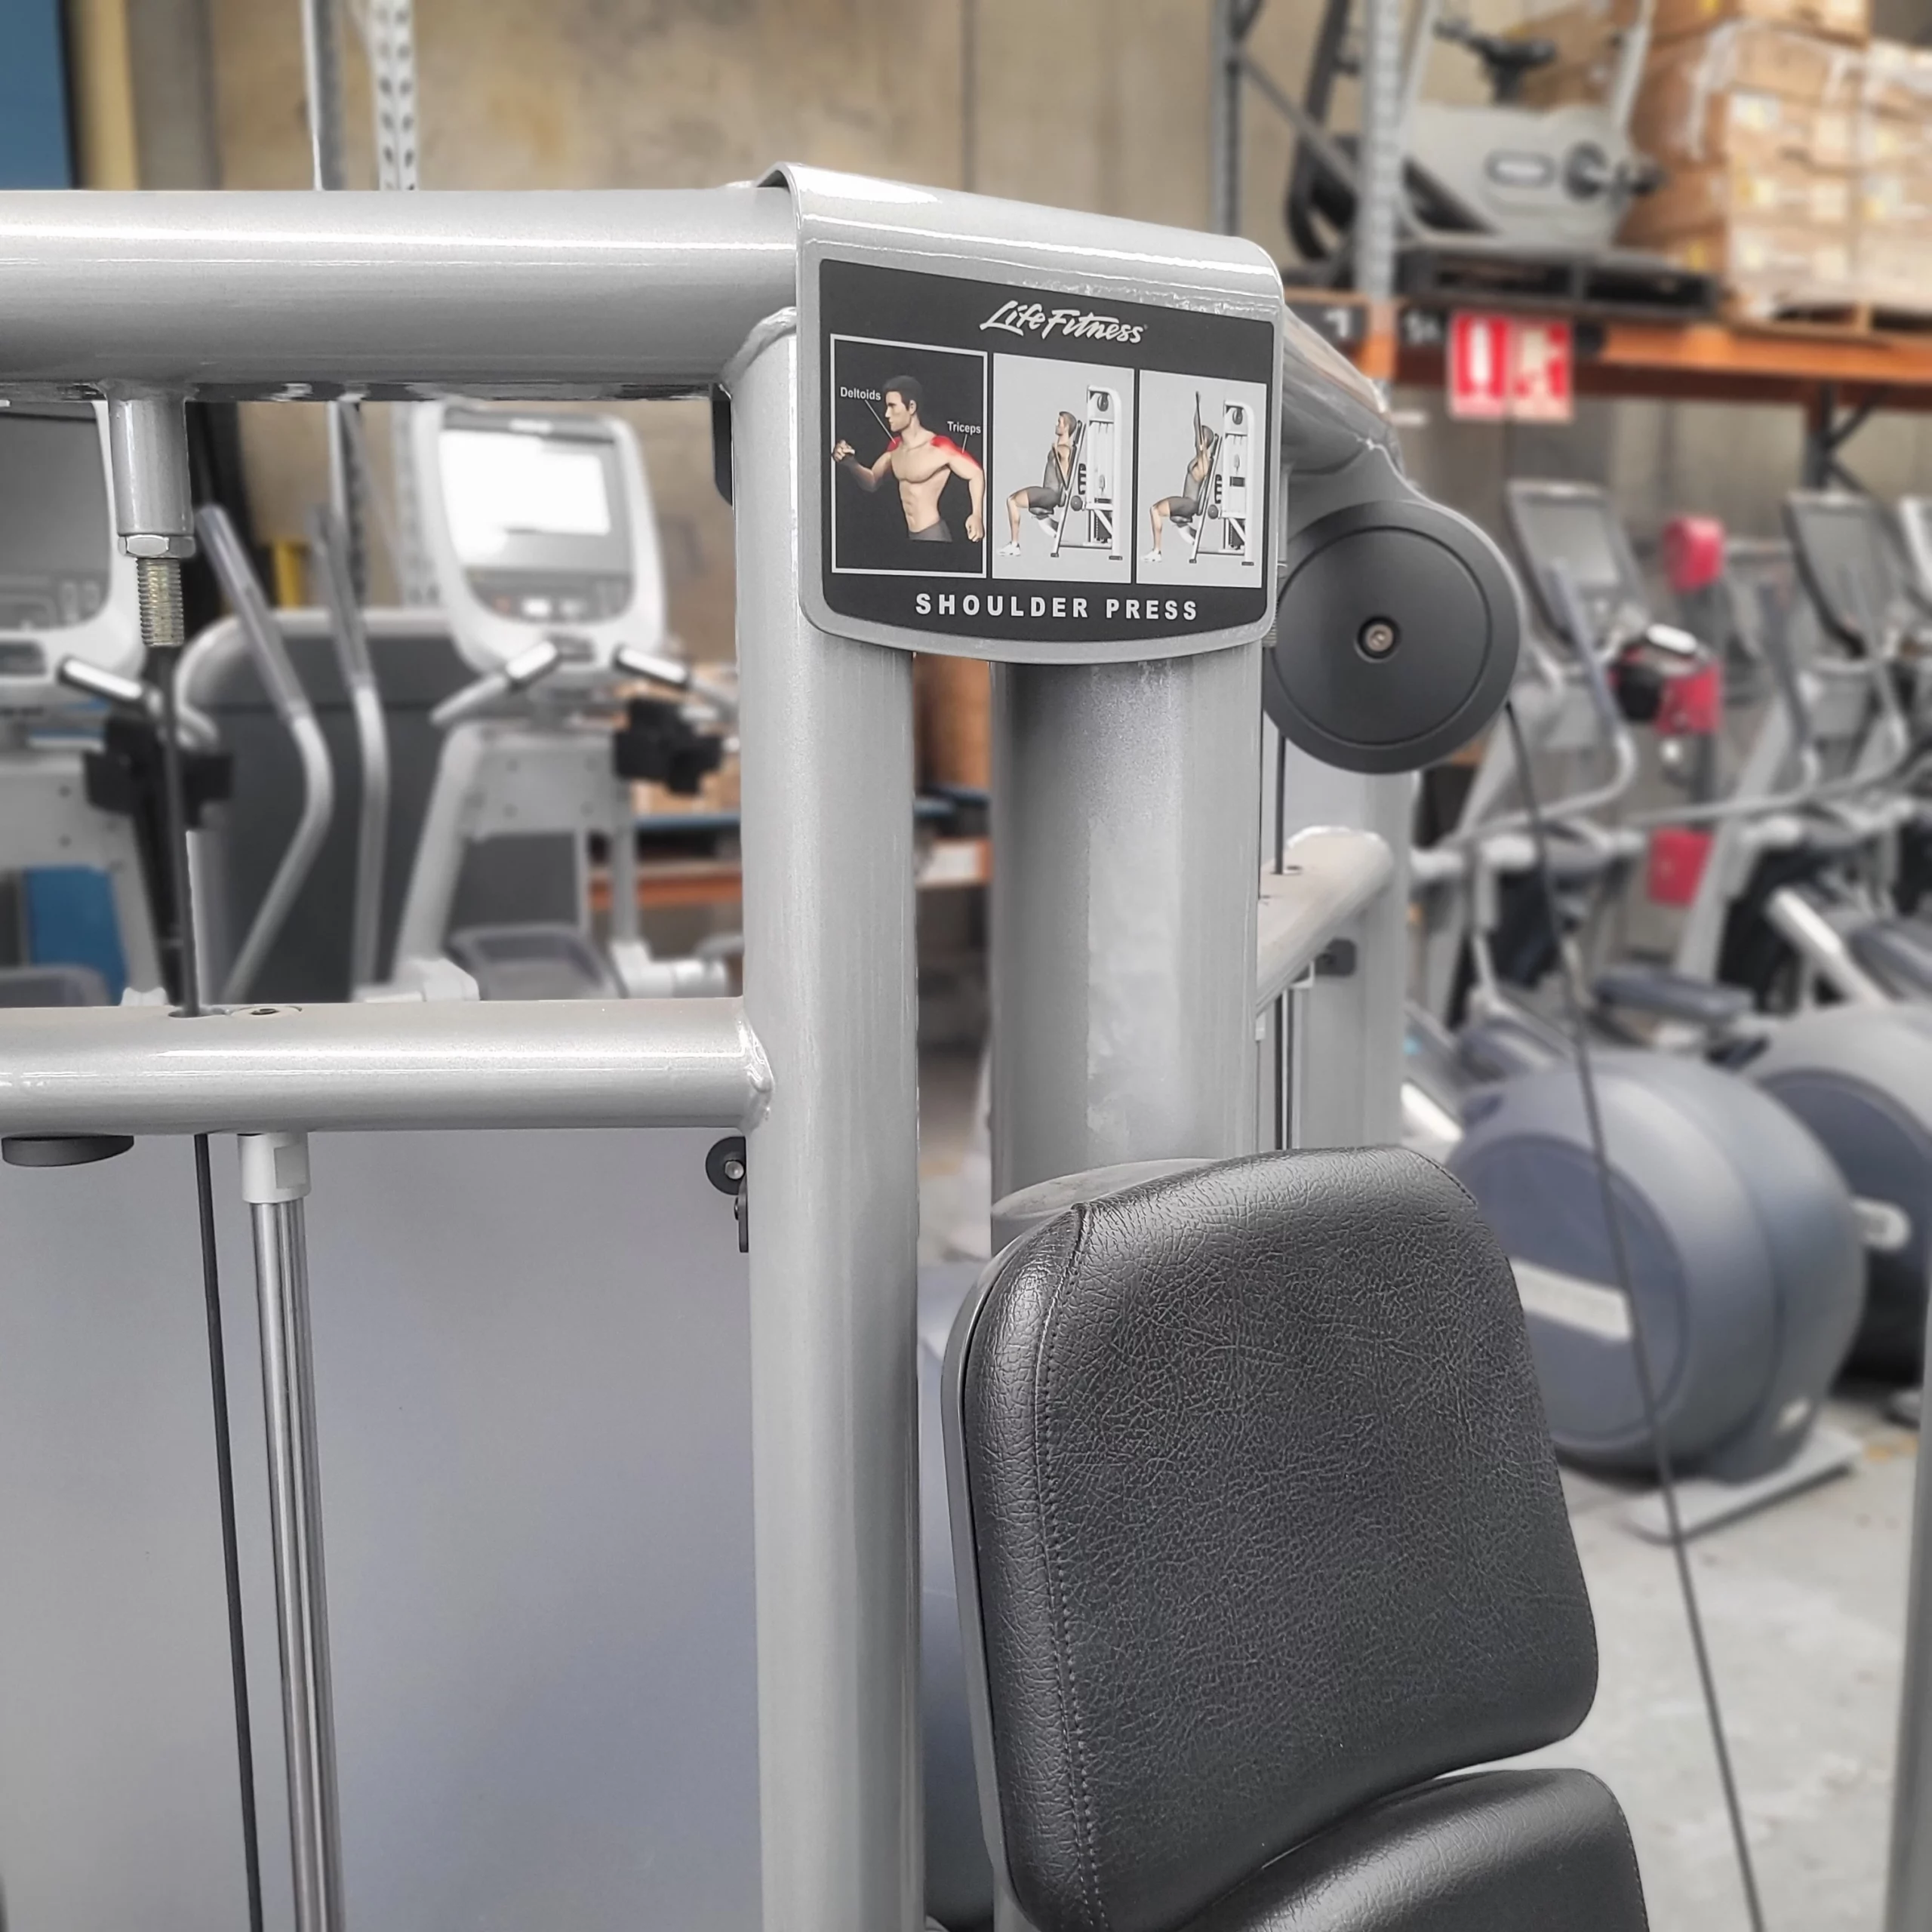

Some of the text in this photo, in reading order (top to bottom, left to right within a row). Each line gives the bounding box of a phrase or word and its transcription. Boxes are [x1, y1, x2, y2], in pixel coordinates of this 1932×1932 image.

[980, 300, 1144, 343] Life Fitness
[840, 386, 881, 401] Deltoids
[947, 420, 981, 435] Triceps
[915, 593, 1197, 620] SHOULDER PRESS
